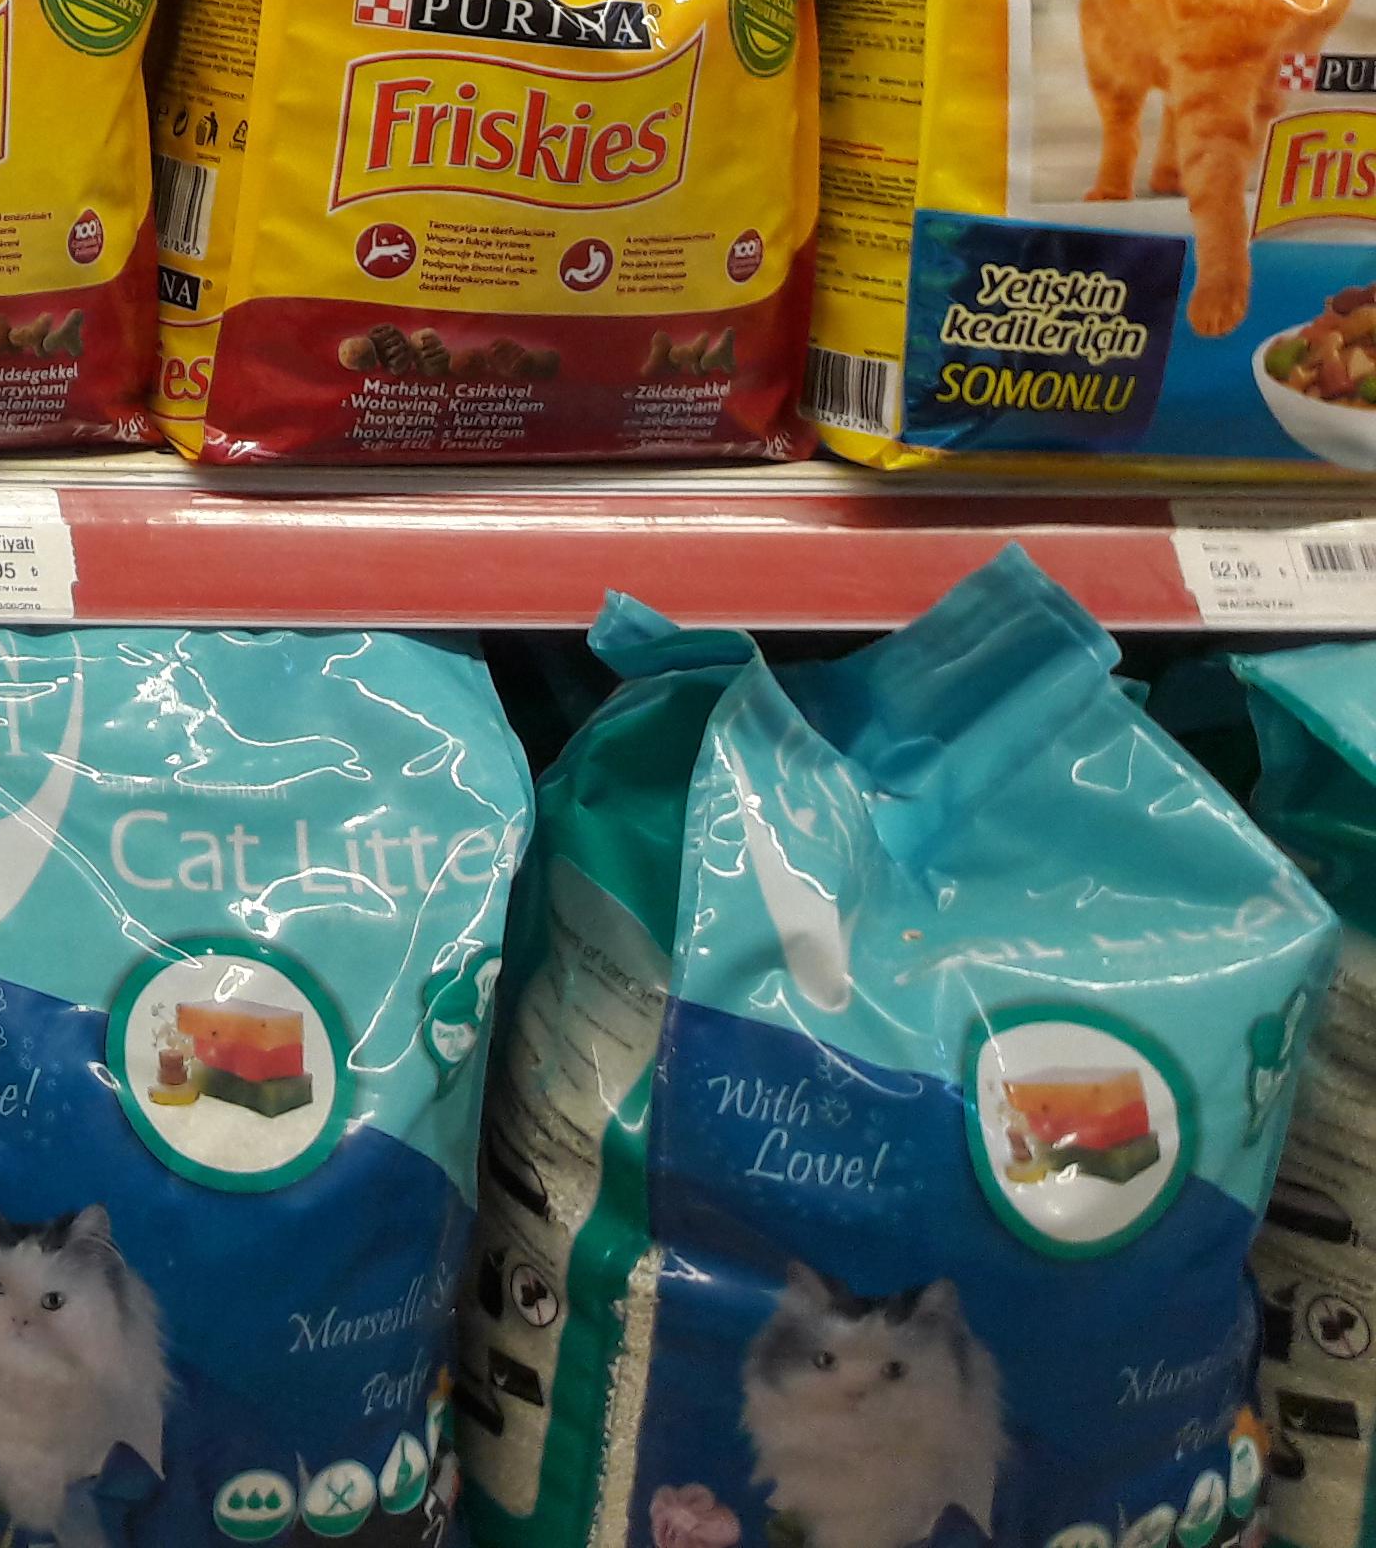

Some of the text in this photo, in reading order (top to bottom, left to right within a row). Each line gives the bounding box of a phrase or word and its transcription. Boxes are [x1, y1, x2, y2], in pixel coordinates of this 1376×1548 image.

[366, 79, 668, 184] Friskies
[977, 263, 1129, 317] Yetişkin
[941, 304, 1147, 365] kediler için
[937, 362, 1137, 415] SOMONLU
[110, 808, 526, 898] Cat Litter
[706, 1073, 812, 1129] With
[746, 1128, 890, 1192] Love!
